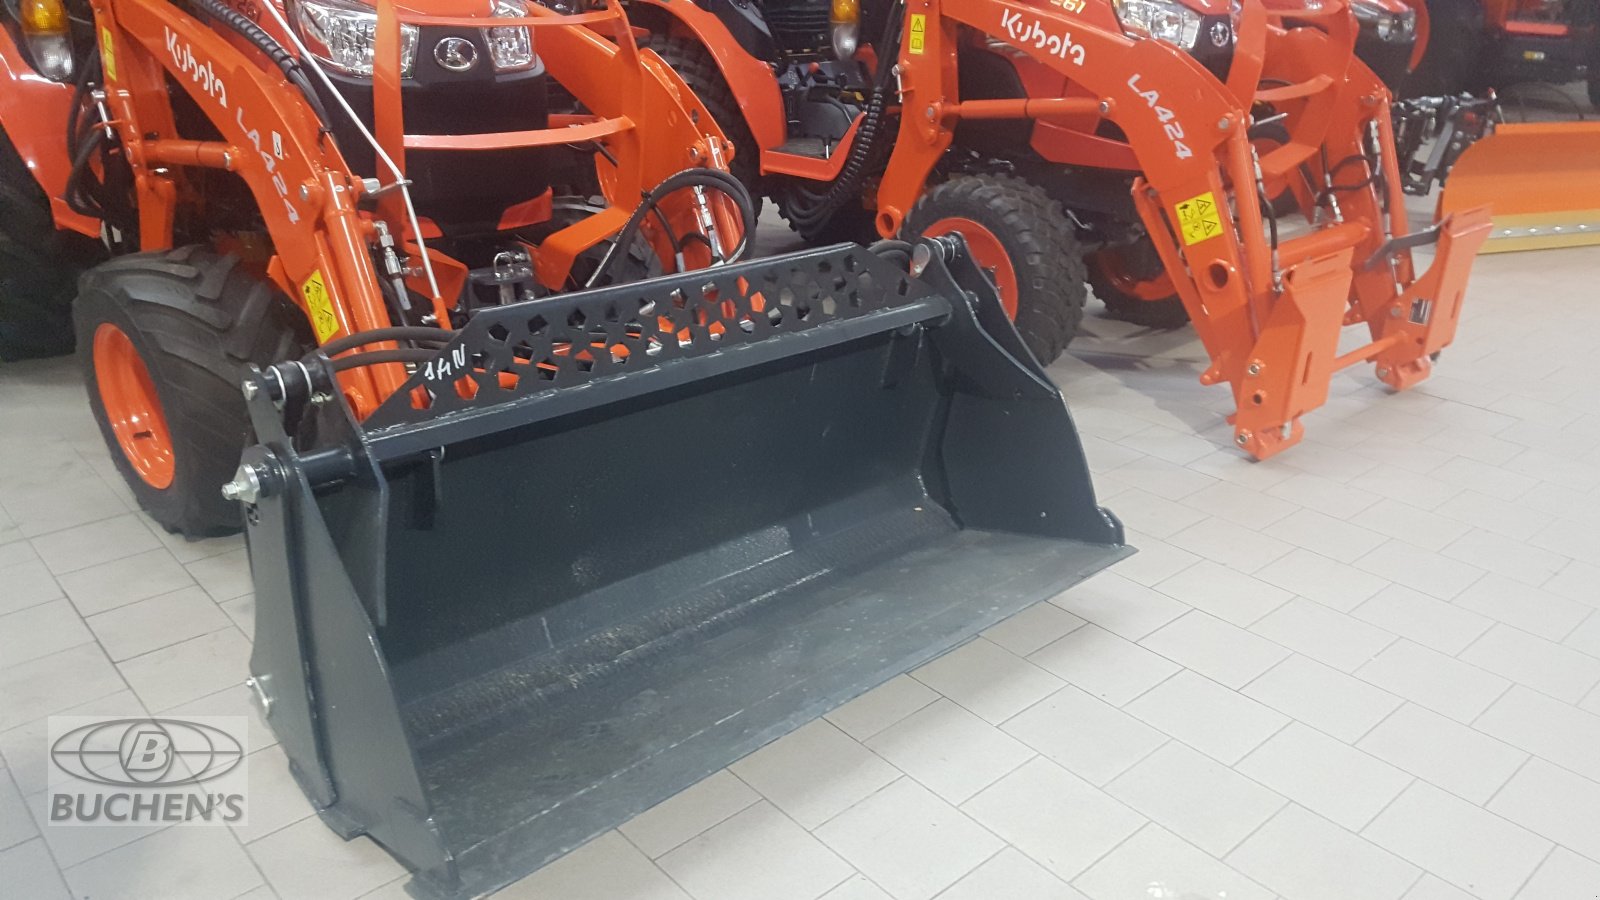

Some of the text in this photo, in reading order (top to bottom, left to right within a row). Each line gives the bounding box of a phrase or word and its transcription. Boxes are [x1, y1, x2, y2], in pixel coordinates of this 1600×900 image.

[1001, 9, 1085, 66] Kubota
[1050, 0, 1086, 14] 61
[164, 26, 227, 108] Kubota
[1127, 73, 1193, 160] LA424
[236, 107, 299, 225] LA424
